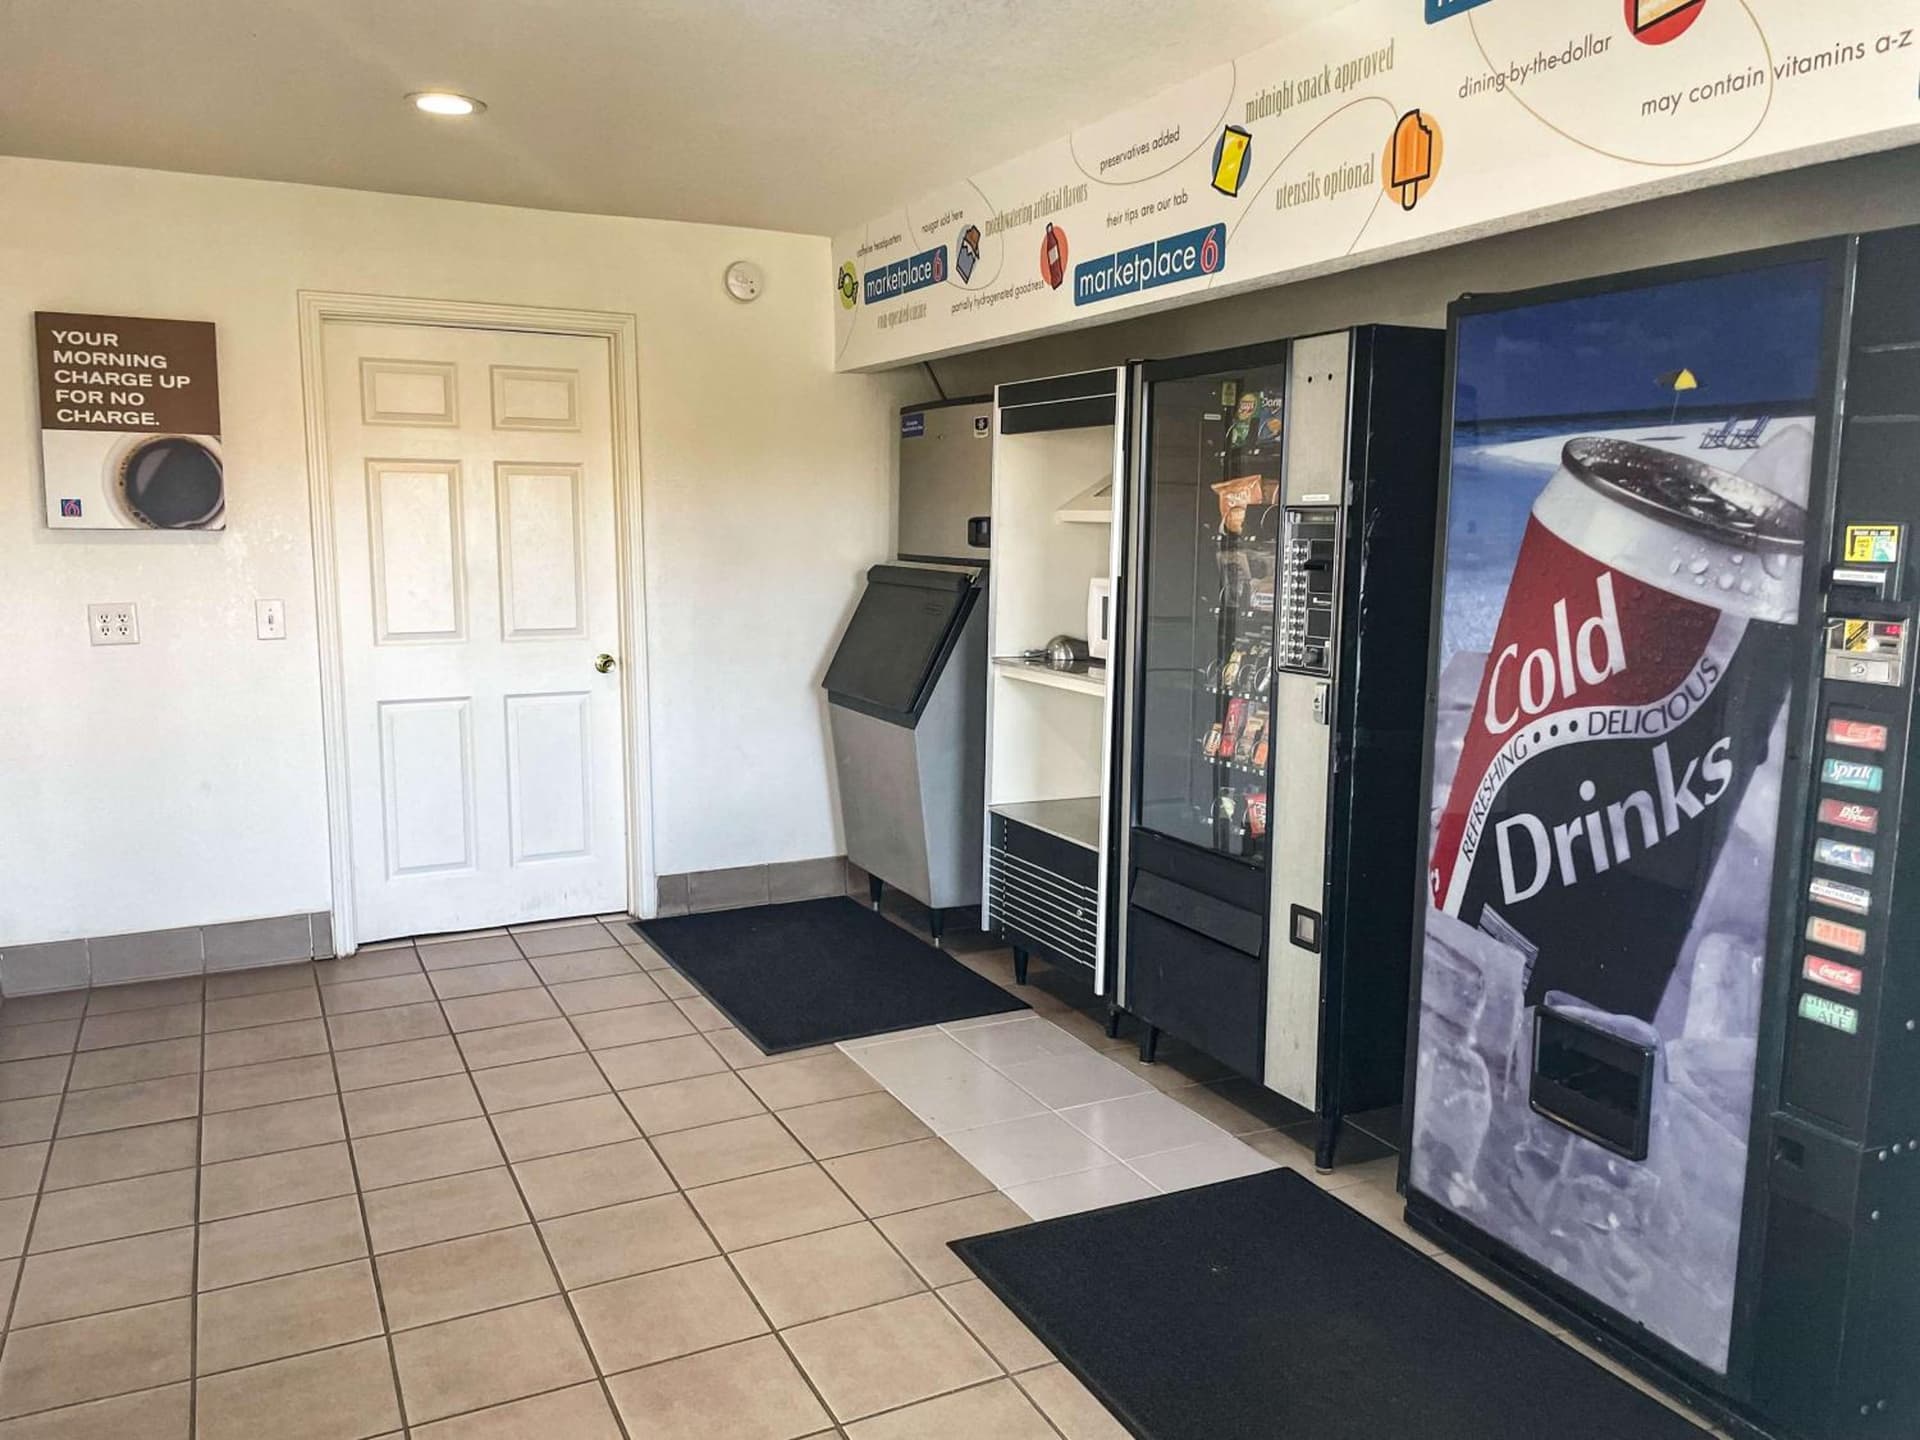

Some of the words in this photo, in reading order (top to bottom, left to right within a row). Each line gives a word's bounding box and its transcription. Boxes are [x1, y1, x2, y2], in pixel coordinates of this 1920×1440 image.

[1245, 80, 1294, 124] midnight
[1297, 64, 1331, 104] snack
[1334, 37, 1394, 93] approved
[1458, 34, 1612, 98] dining-by-the-dollar
[1641, 91, 1682, 117] may
[1688, 67, 1764, 103] contain
[1773, 42, 1865, 81] vitamins
[1875, 28, 1914, 54] a-z
[1100, 141, 1150, 175] preservatives
[1152, 124, 1180, 150] added
[1034, 186, 1062, 219] artificial
[1063, 184, 1088, 209] flavors
[1276, 172, 1321, 211] utensils
[1323, 152, 1375, 200] optional
[1106, 212, 1123, 228] their
[1125, 208, 1138, 225] tips
[1141, 203, 1155, 217] are
[1157, 197, 1171, 212] our
[1173, 188, 1188, 206] tab
[867, 259, 932, 297] marketplace
[932, 250, 943, 281] 6
[1079, 241, 1196, 297] marketplace
[1200, 228, 1218, 273] 6
[1014, 280, 1045, 299] goodness
[51, 330, 119, 347] YOUR
[53, 350, 168, 369] MORNING
[54, 370, 153, 387] CHARGE
[159, 375, 191, 389] UP
[55, 389, 103, 404] FOR
[110, 392, 145, 406] NO
[56, 409, 160, 426] CHARGE.
[1484, 571, 1627, 734] Cold
[1461, 734, 1528, 863] REFRESHING
[1588, 656, 1720, 737] DELICIOUS
[1494, 736, 1733, 906] Drinks
